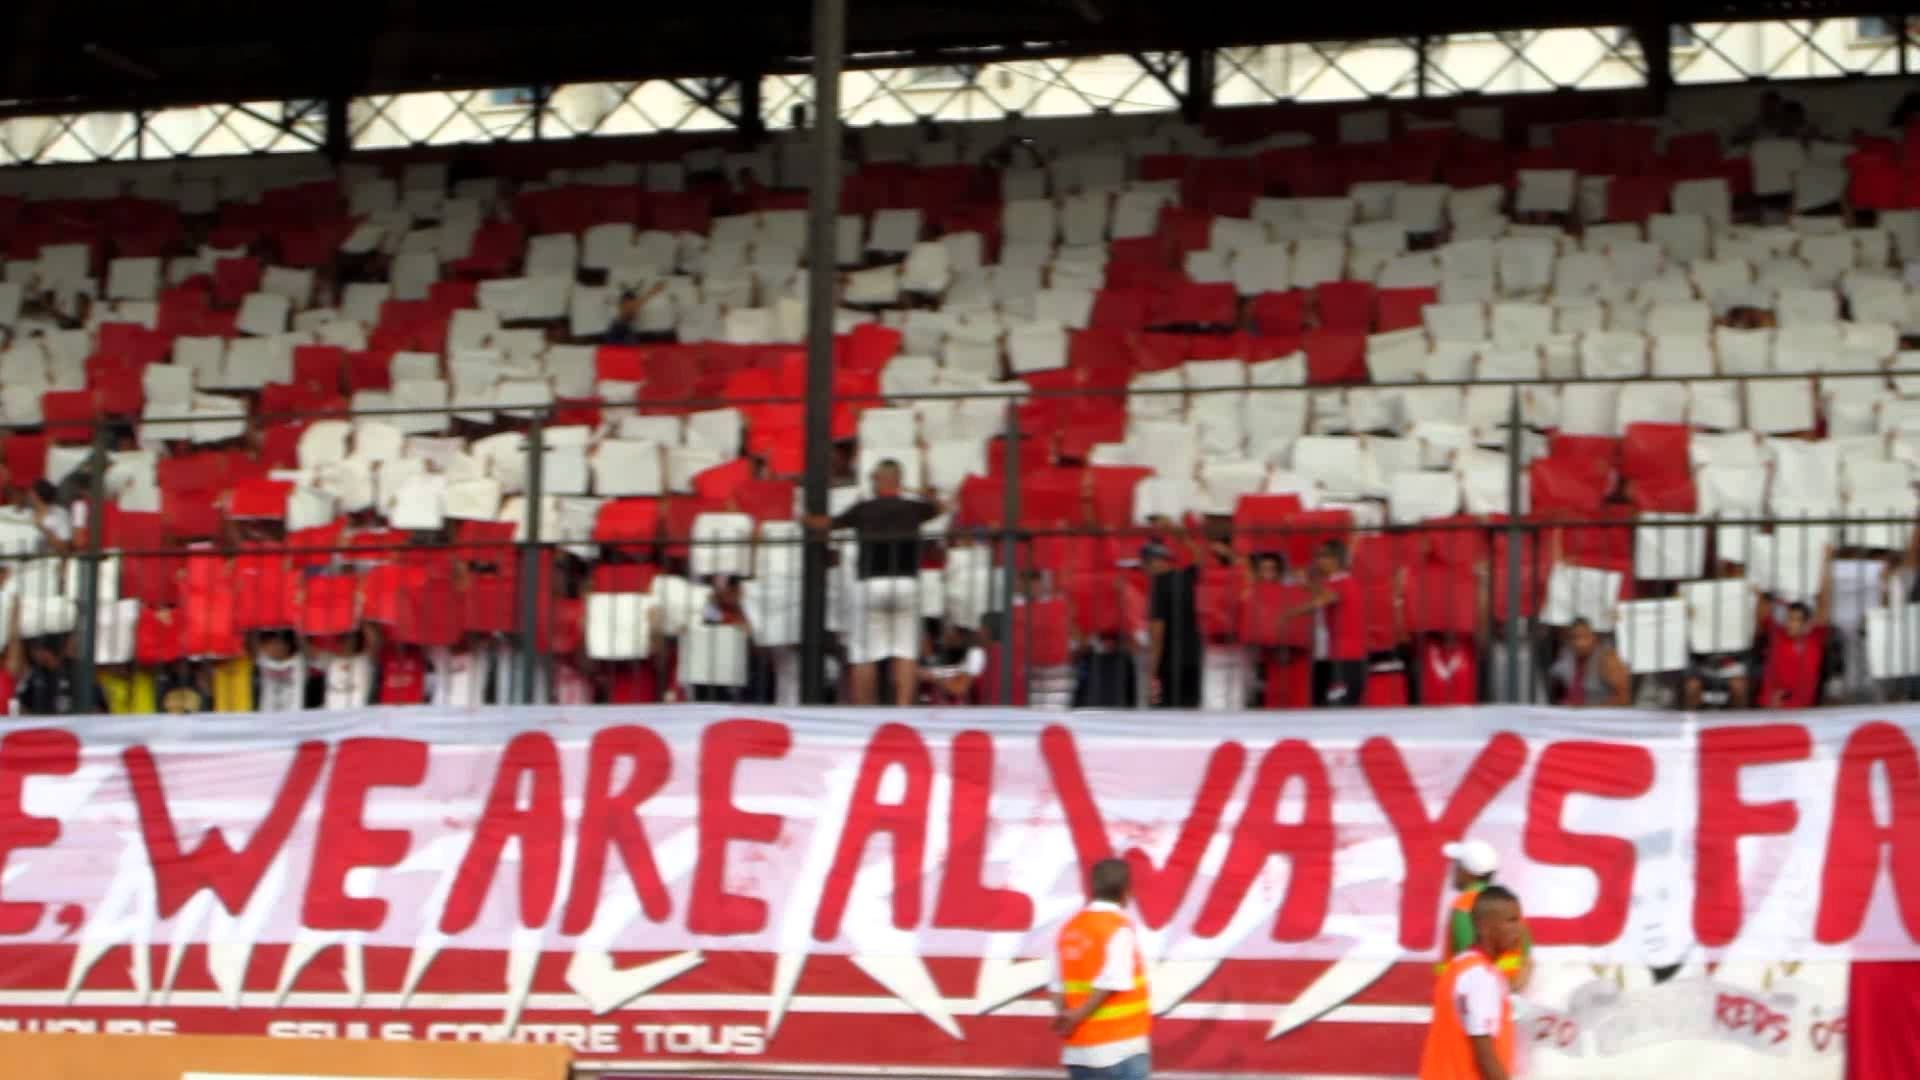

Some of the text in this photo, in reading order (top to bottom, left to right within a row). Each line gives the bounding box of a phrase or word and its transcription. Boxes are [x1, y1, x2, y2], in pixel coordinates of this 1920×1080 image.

[119, 736, 431, 932] WE
[438, 719, 793, 936] ARE
[811, 722, 1655, 952] ALWAYS
[1692, 720, 1920, 947] FA
[634, 1024, 766, 1055] TOUS
